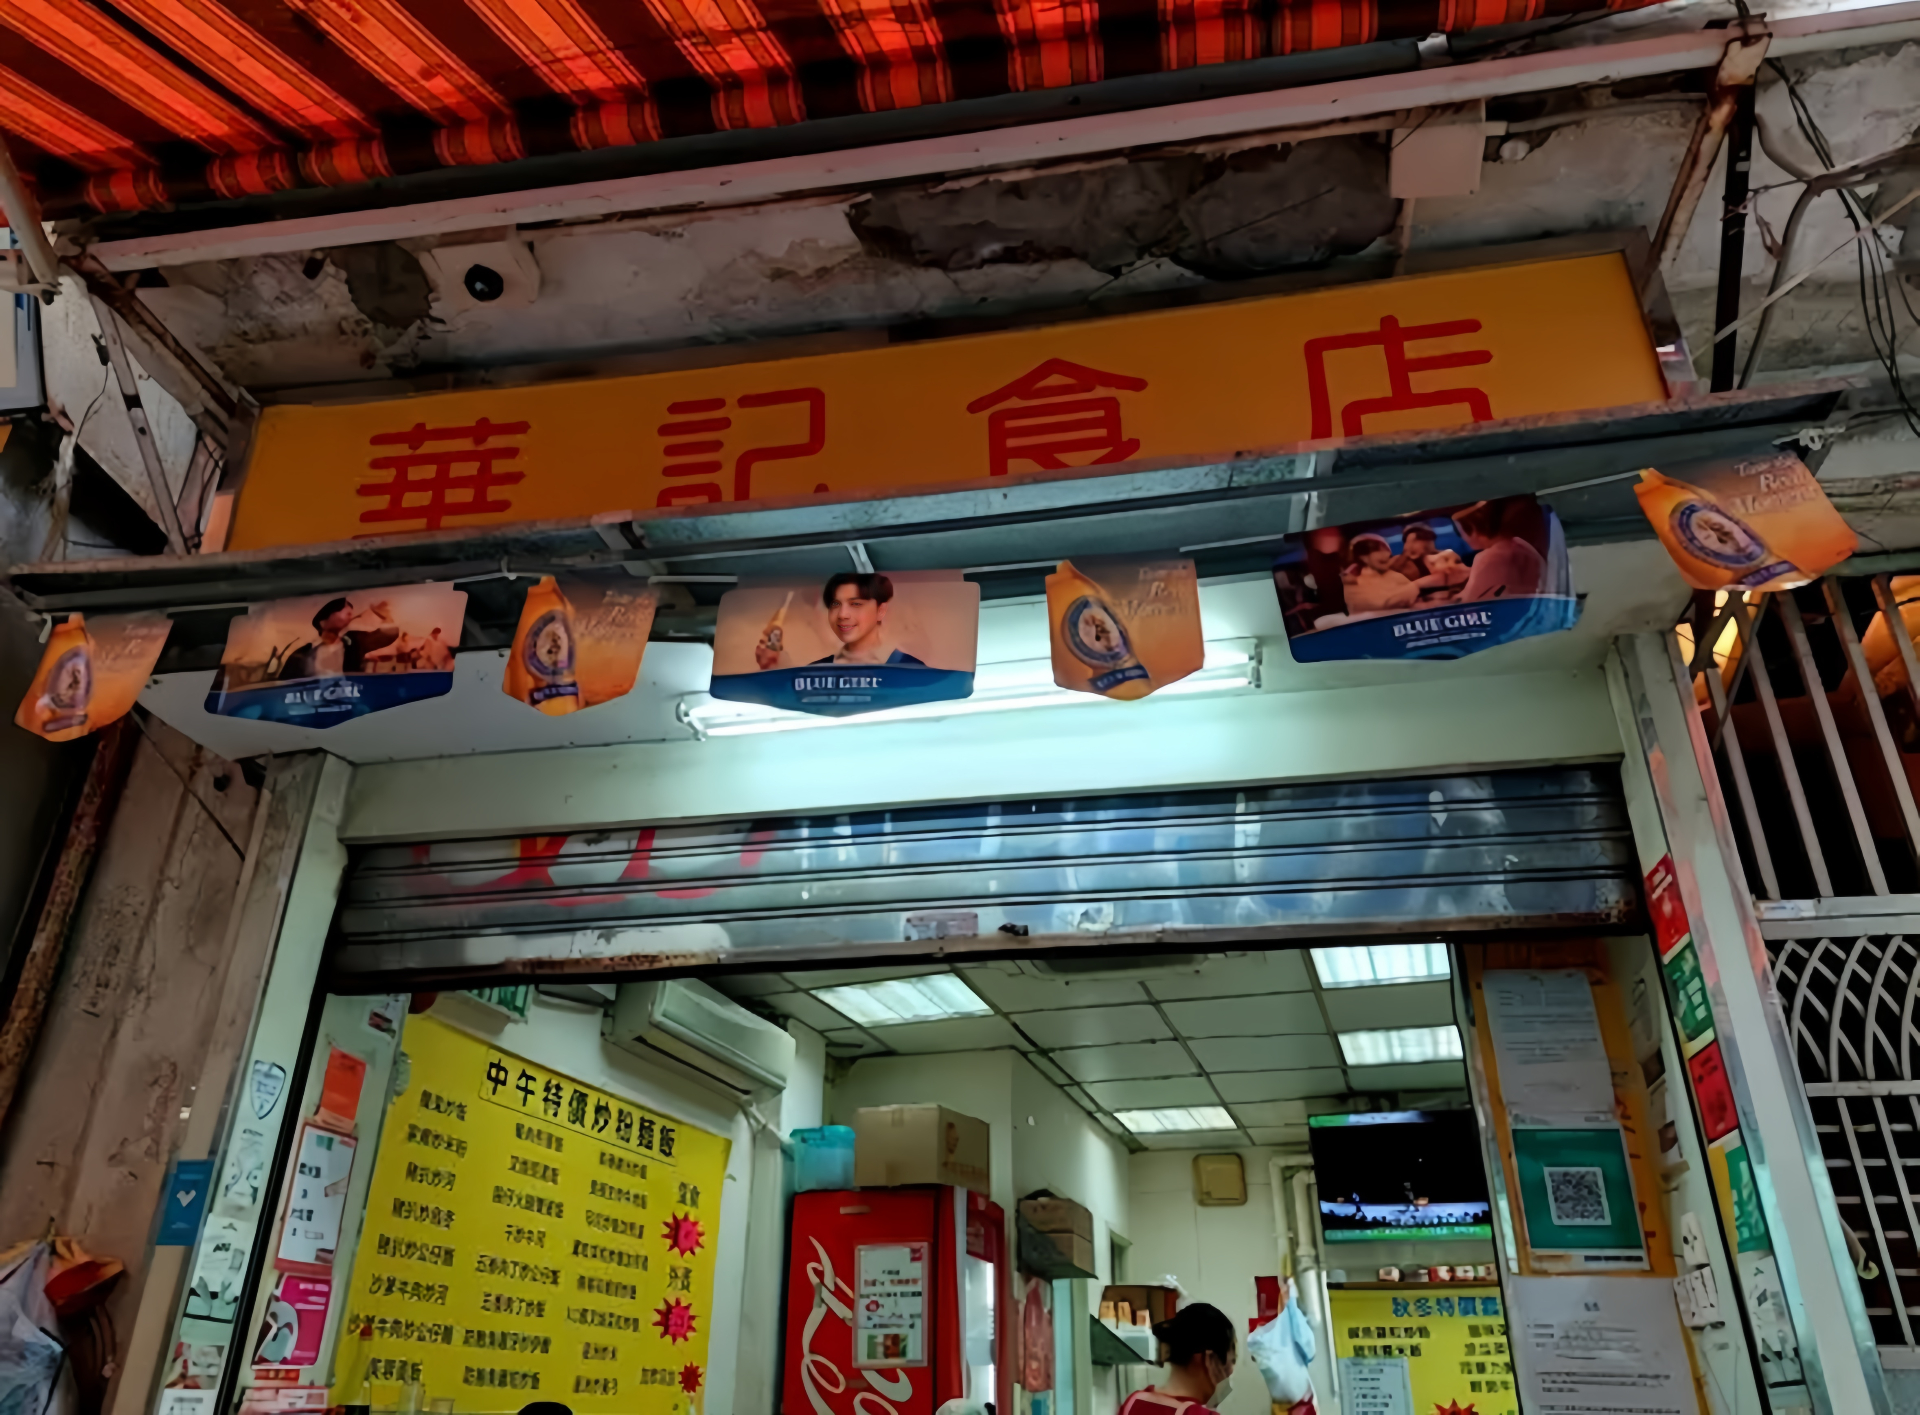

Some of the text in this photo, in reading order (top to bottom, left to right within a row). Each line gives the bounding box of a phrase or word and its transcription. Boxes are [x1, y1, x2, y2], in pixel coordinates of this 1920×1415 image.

[1393, 610, 1492, 638] BLUE GIRL
[794, 677, 836, 691] BLUE
